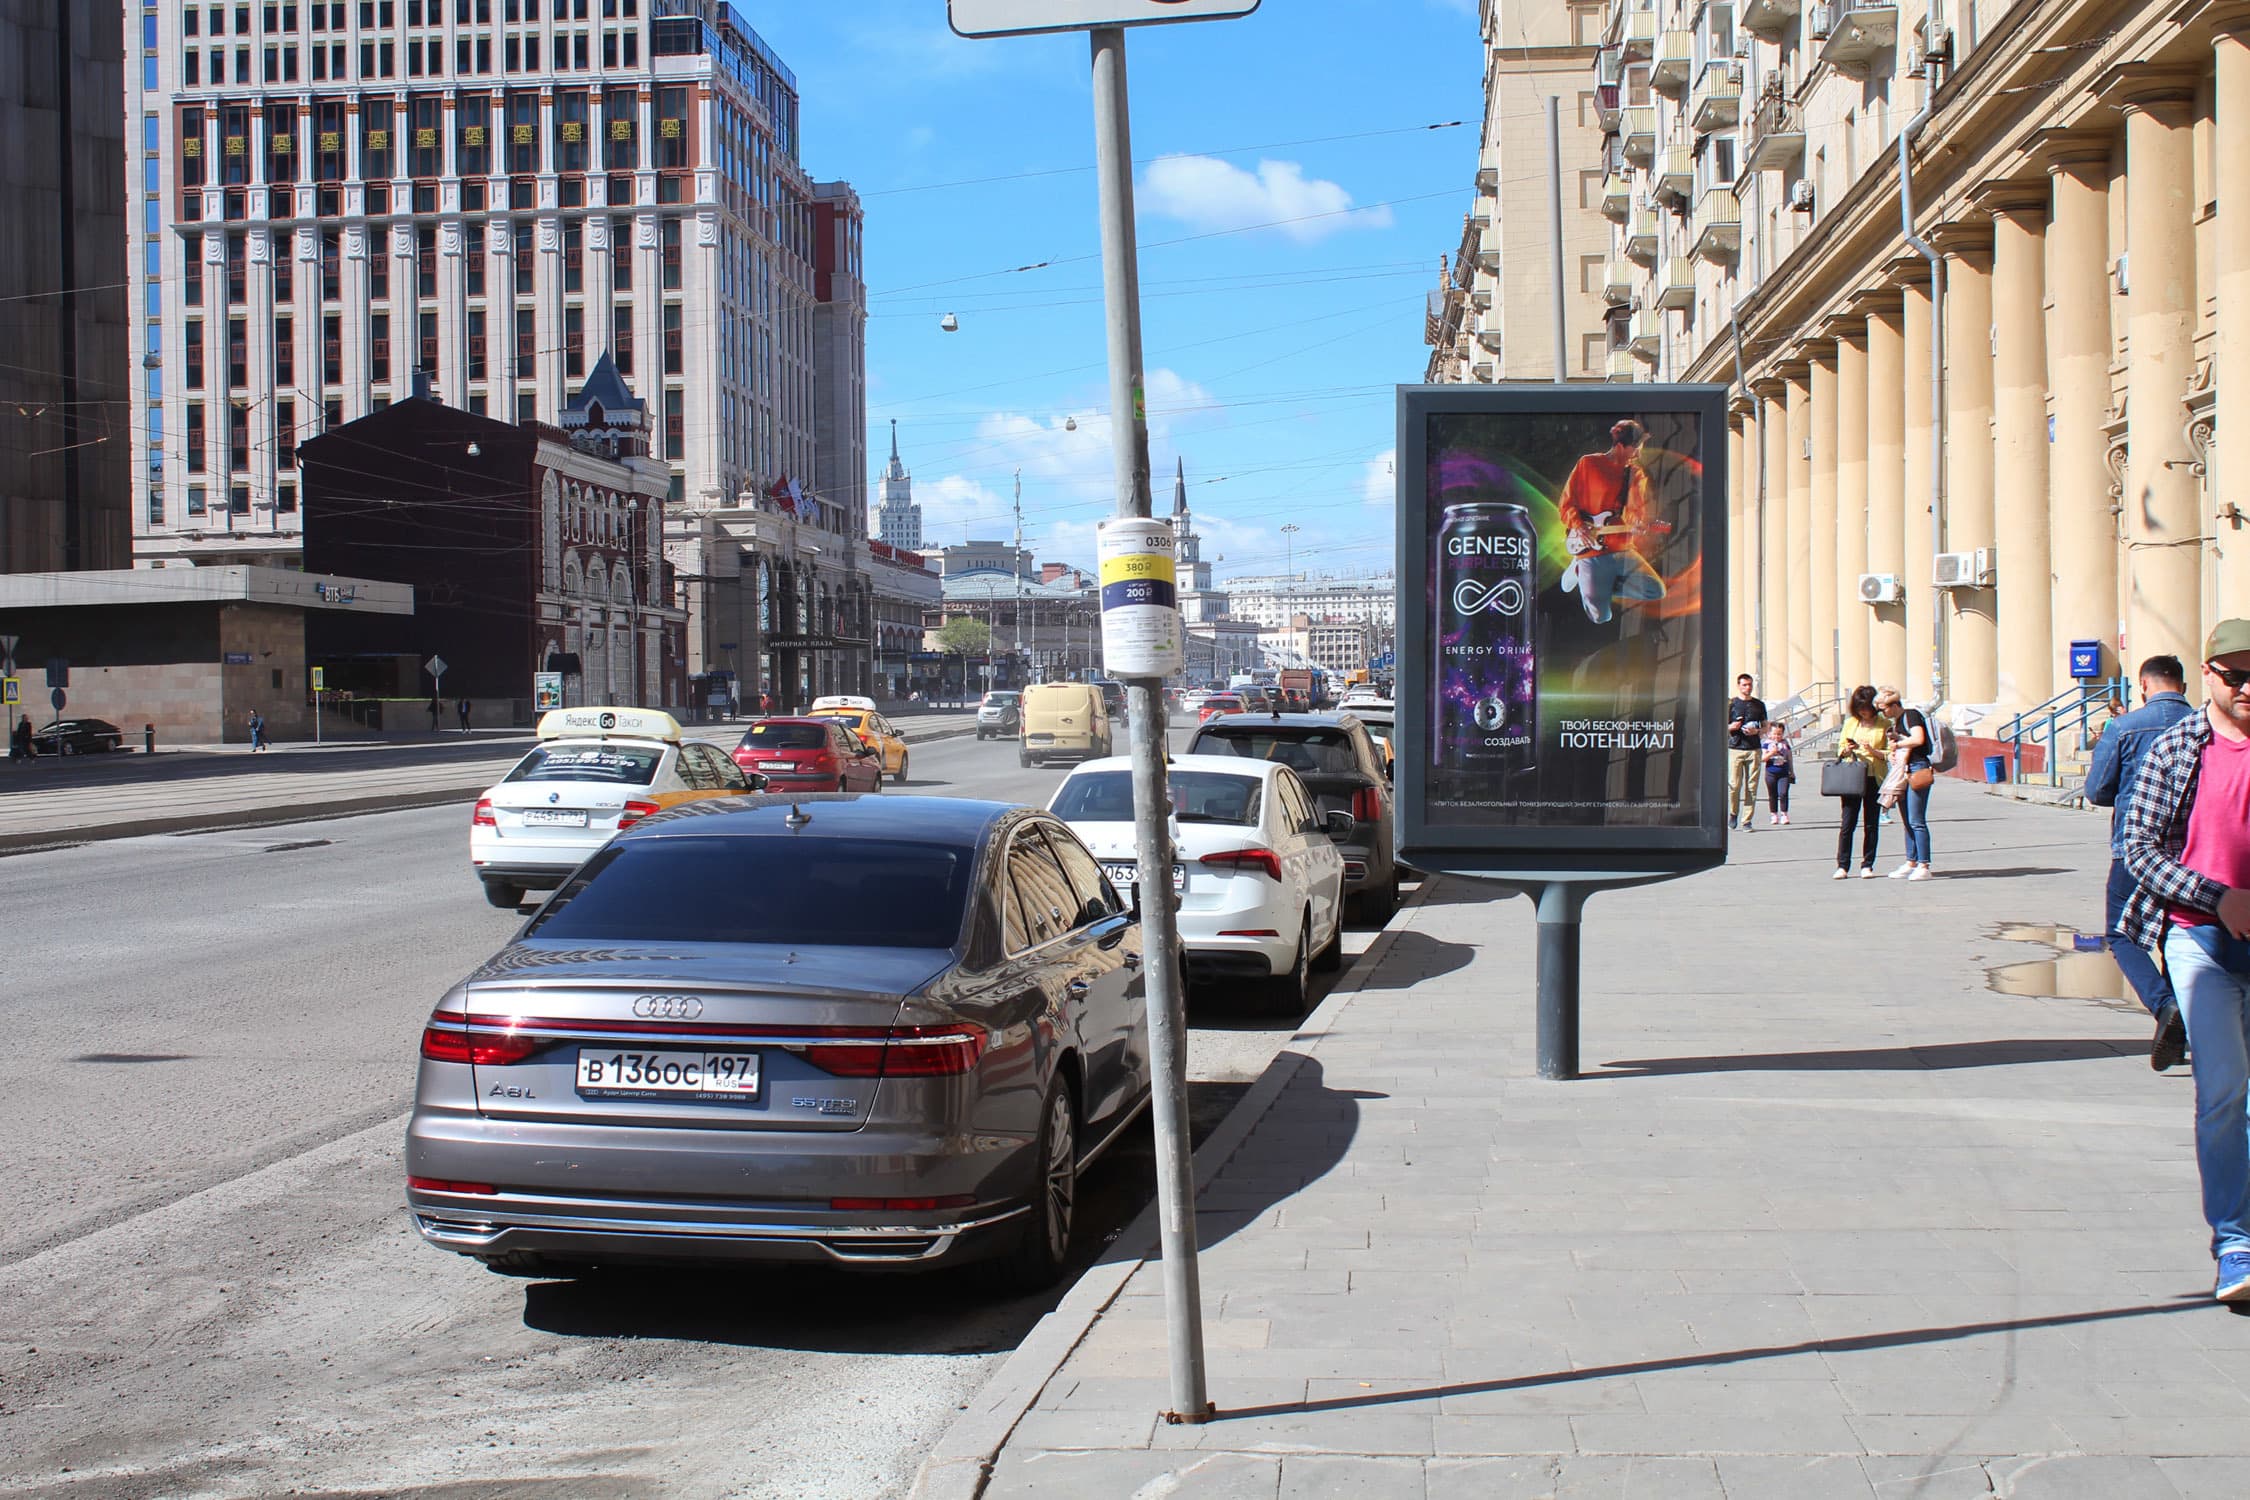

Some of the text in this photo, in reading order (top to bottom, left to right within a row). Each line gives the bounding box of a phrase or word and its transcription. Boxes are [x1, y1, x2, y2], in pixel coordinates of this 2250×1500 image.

[1146, 537, 1171, 547] 0306
[1448, 536, 1530, 556] GENESIS
[1126, 562, 1144, 572] 380
[1502, 557, 1530, 571] STAR
[325, 586, 341, 602] ВТБ
[1126, 588, 1145, 598] 200
[1446, 646, 1531, 655] ENERGY DRINK
[565, 714, 643, 728] Яндекс Go Такси
[1560, 719, 1674, 731] ТВОЙ БЕСКОНЕЧНЫЙ
[1484, 736, 1531, 747] СОЗДАВАТЬ
[1560, 733, 1674, 750] ПОТЕНЦИАЛ
[707, 1056, 750, 1081] 197
[716, 1079, 737, 1088] RUS
[791, 1097, 816, 1107] 55
